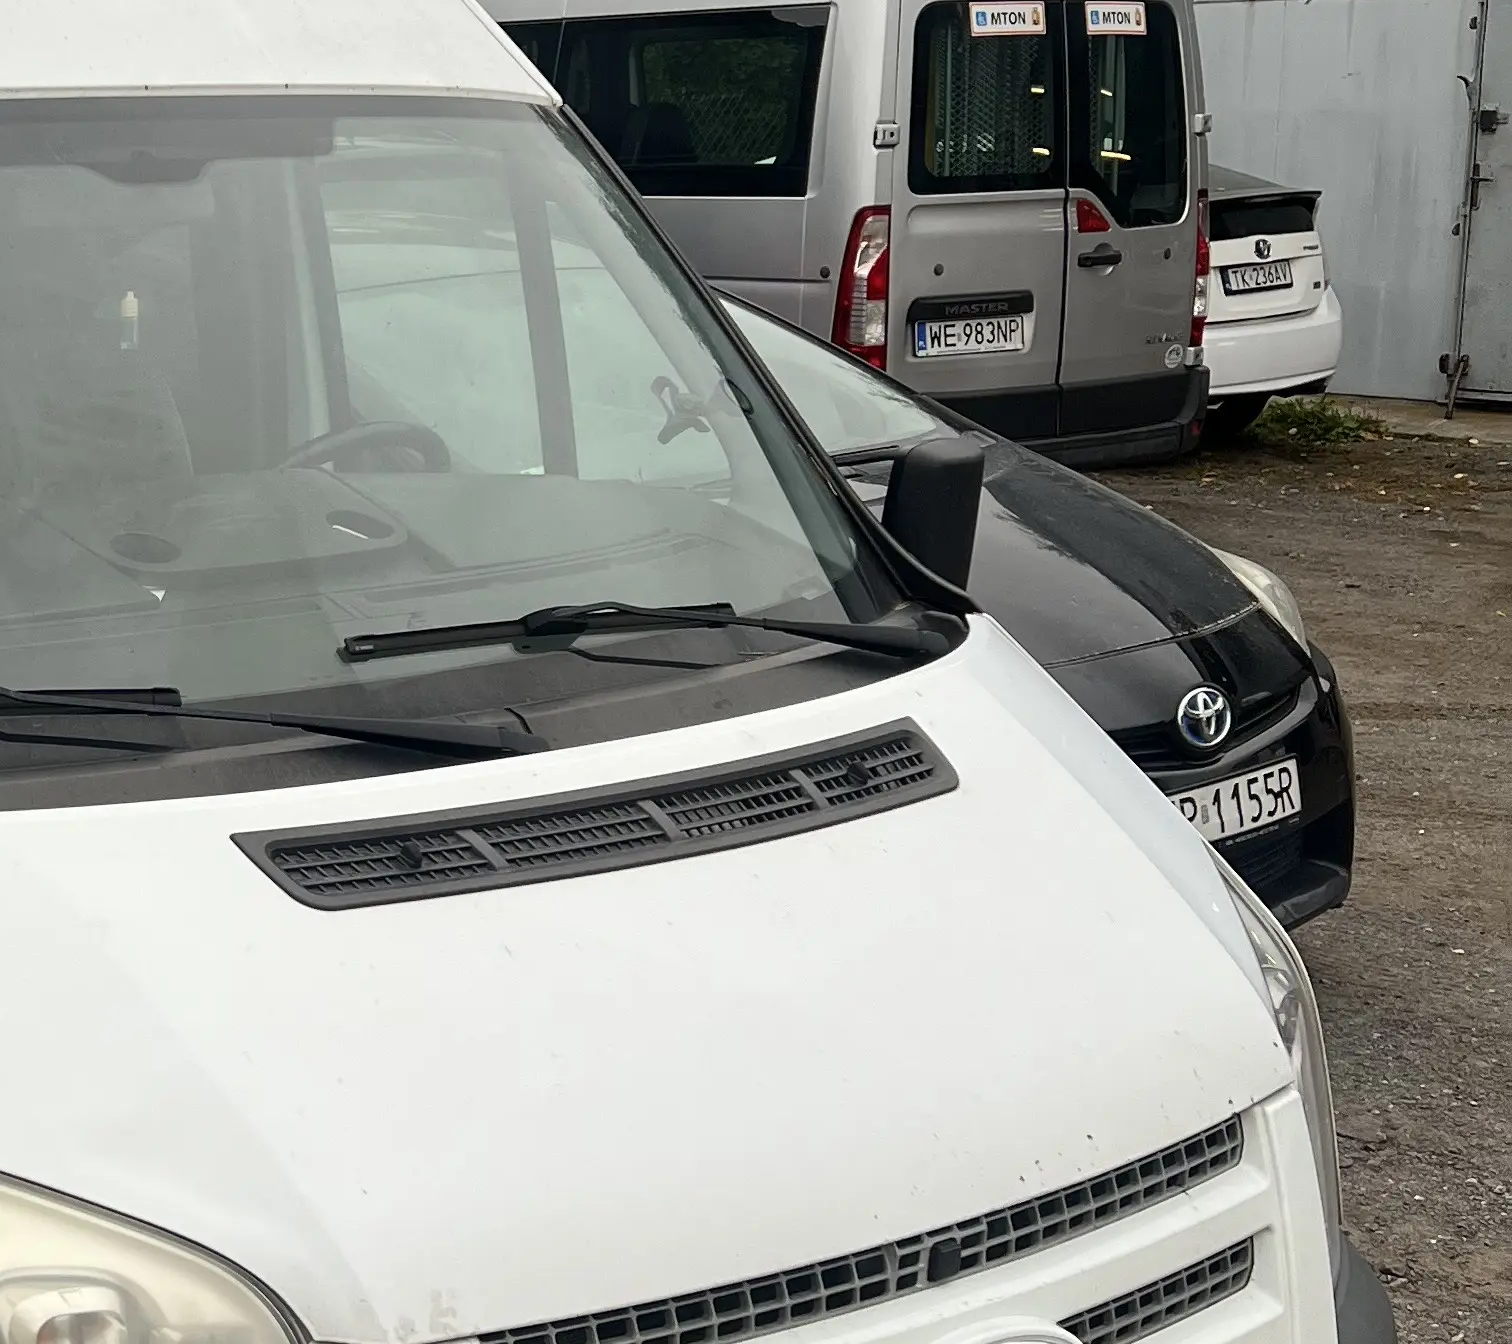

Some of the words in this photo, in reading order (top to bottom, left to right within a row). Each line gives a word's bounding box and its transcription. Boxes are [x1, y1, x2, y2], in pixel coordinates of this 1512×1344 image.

[990, 11, 1026, 26] MTON
[1102, 11, 1131, 25] MTON
[1231, 268, 1250, 288] TK
[1252, 262, 1287, 286] 236AV
[945, 302, 1009, 315] MASTER
[929, 324, 957, 348] WE
[963, 319, 1019, 346] 983NP
[1212, 766, 1295, 834] 1155R
